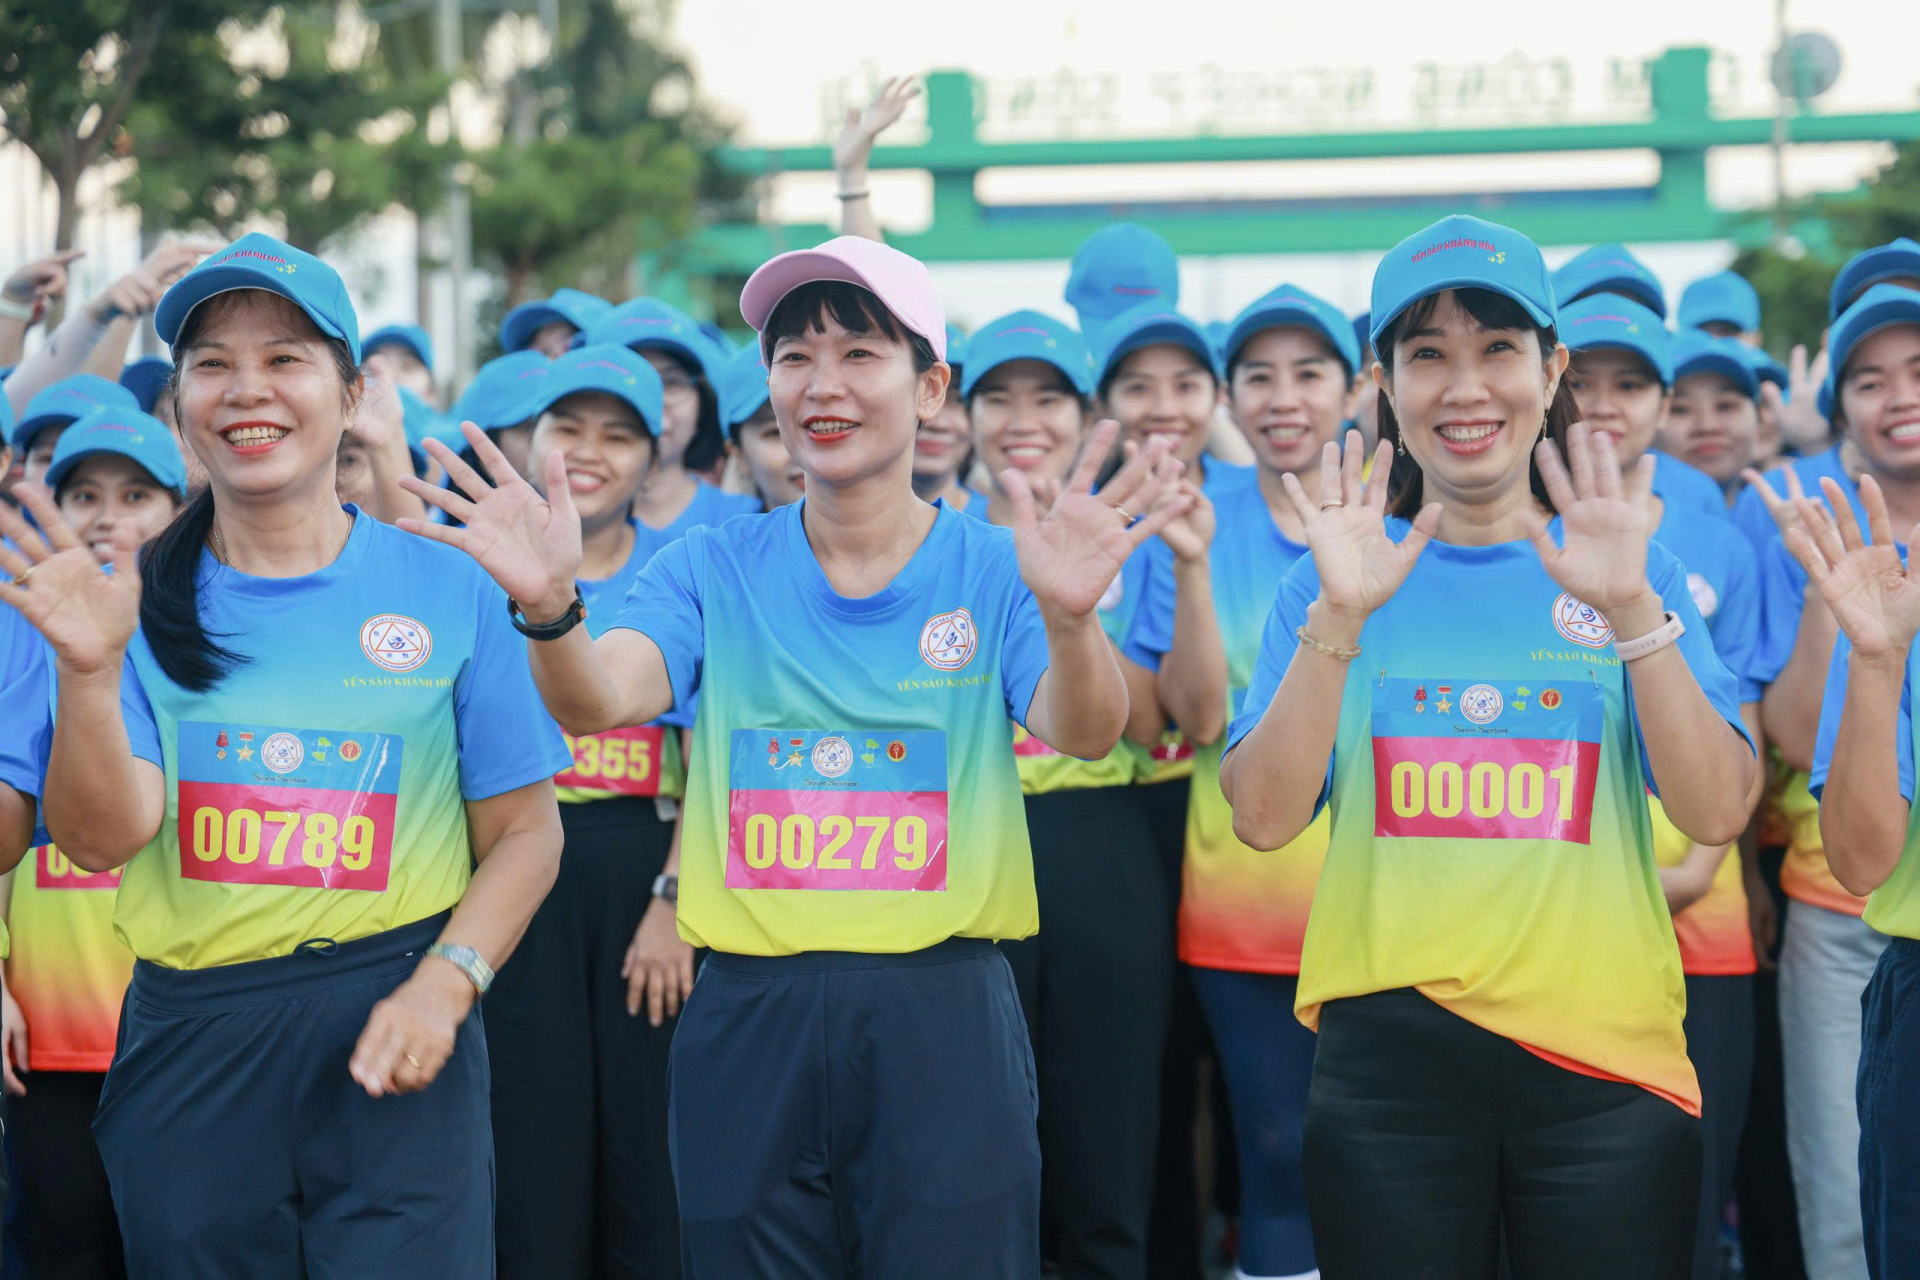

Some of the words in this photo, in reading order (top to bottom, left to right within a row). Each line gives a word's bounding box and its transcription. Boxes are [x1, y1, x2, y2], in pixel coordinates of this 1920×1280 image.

[1530, 648, 1555, 660] YẾN
[1557, 649, 1580, 660] SÀO
[343, 675, 366, 687] YẾN
[369, 675, 392, 686] SÀO
[435, 676, 456, 688] HÒ
[922, 676, 944, 689] SÀO
[560, 733, 651, 781] 355
[1390, 761, 1575, 821] 00001
[193, 806, 375, 871] 00789
[745, 813, 928, 871] 00279
